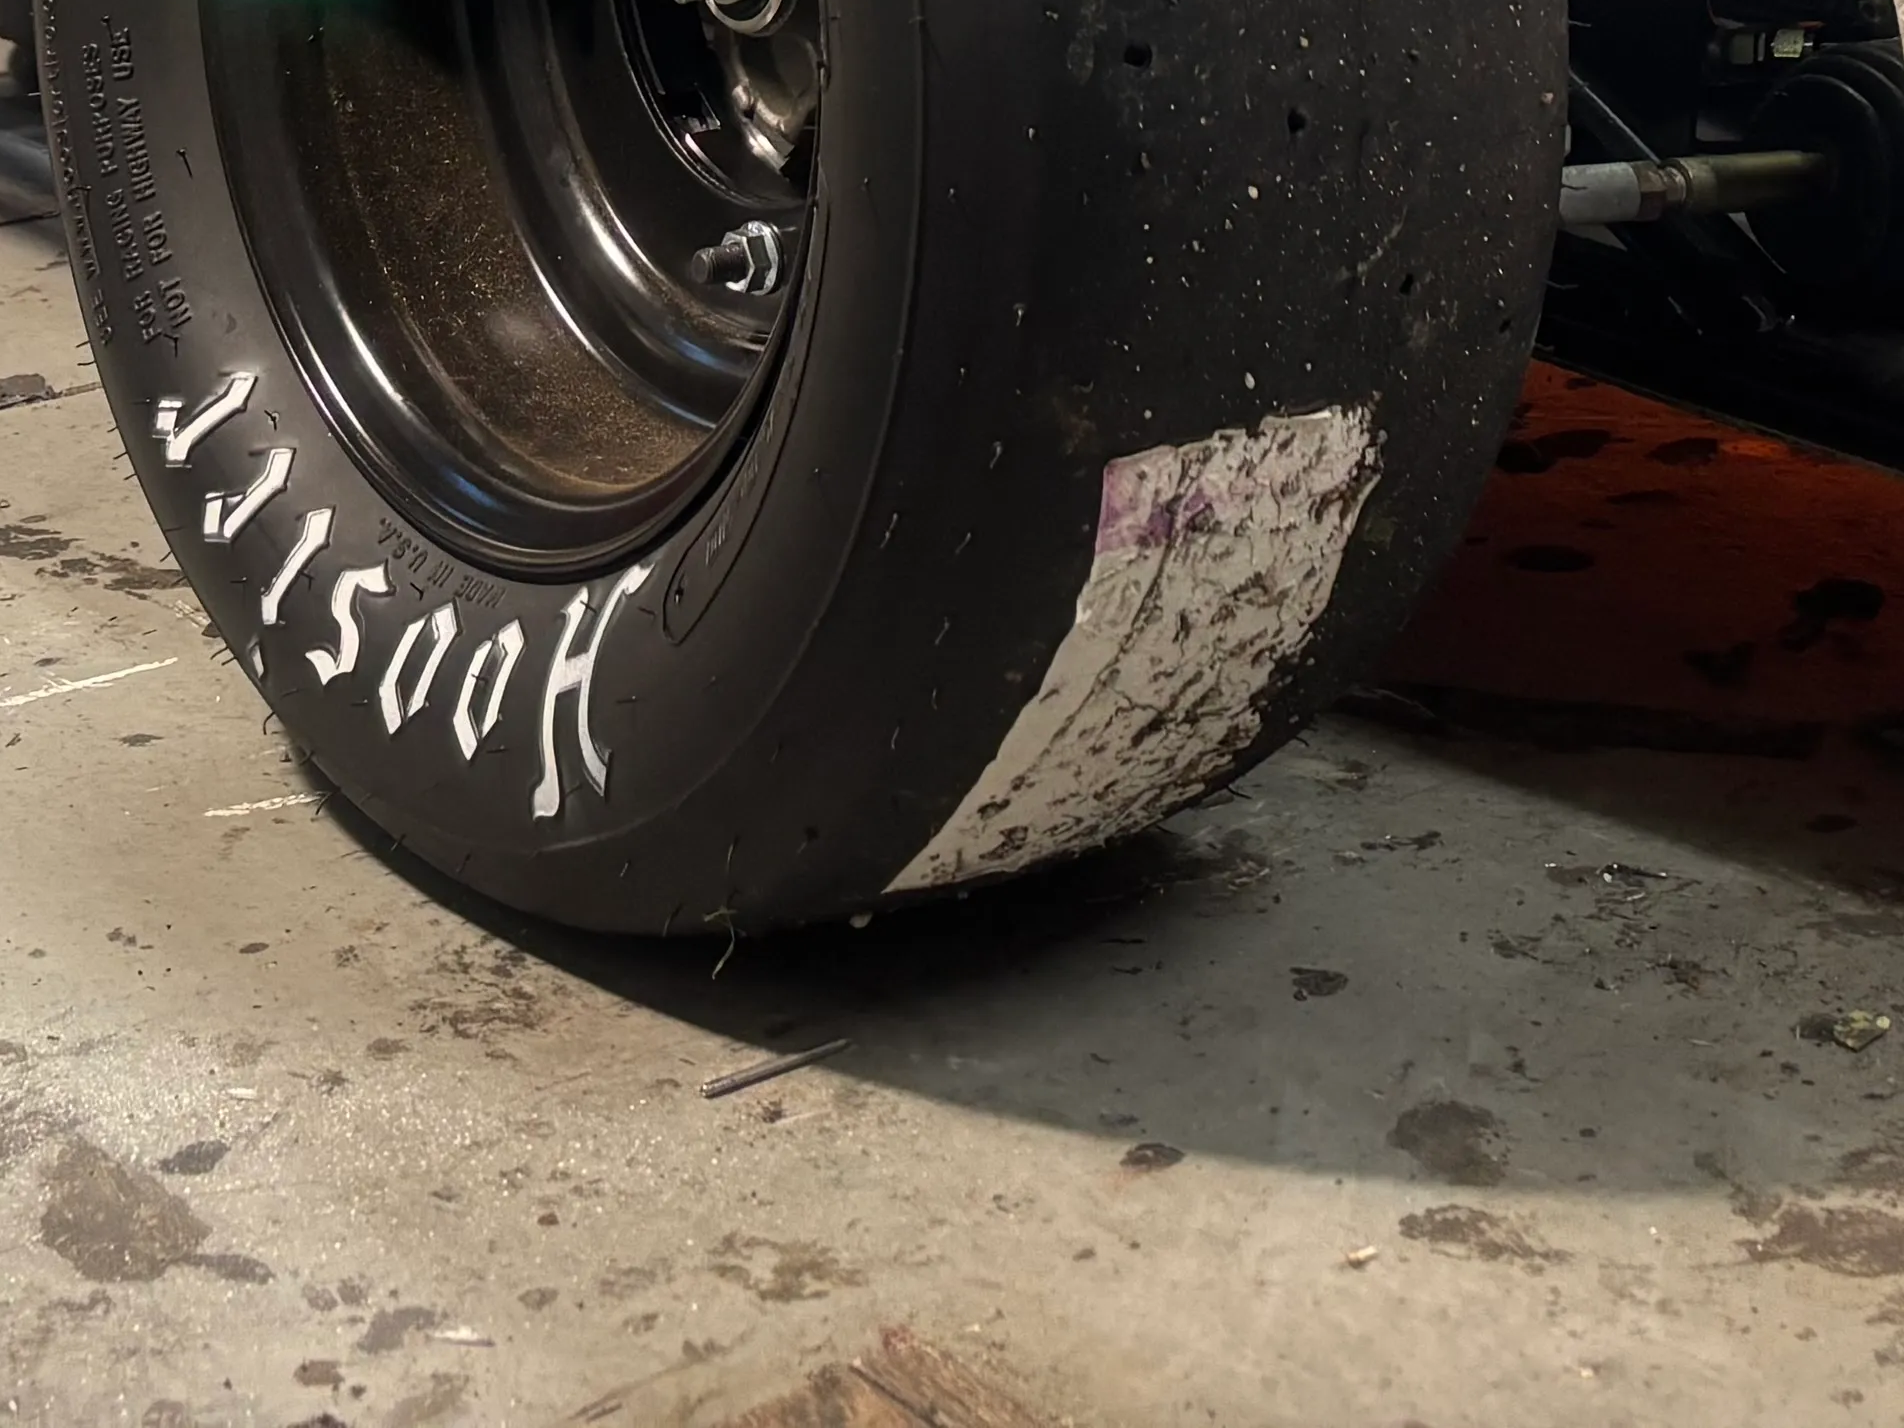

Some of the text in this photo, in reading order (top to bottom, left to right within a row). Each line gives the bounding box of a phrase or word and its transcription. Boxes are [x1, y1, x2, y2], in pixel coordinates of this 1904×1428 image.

[82, 43, 162, 343] FOR RACING PURPOSES
[110, 27, 194, 330] NOT FOR HIGHWAY USE
[427, 560, 455, 588] IN
[453, 574, 506, 608] MADE
